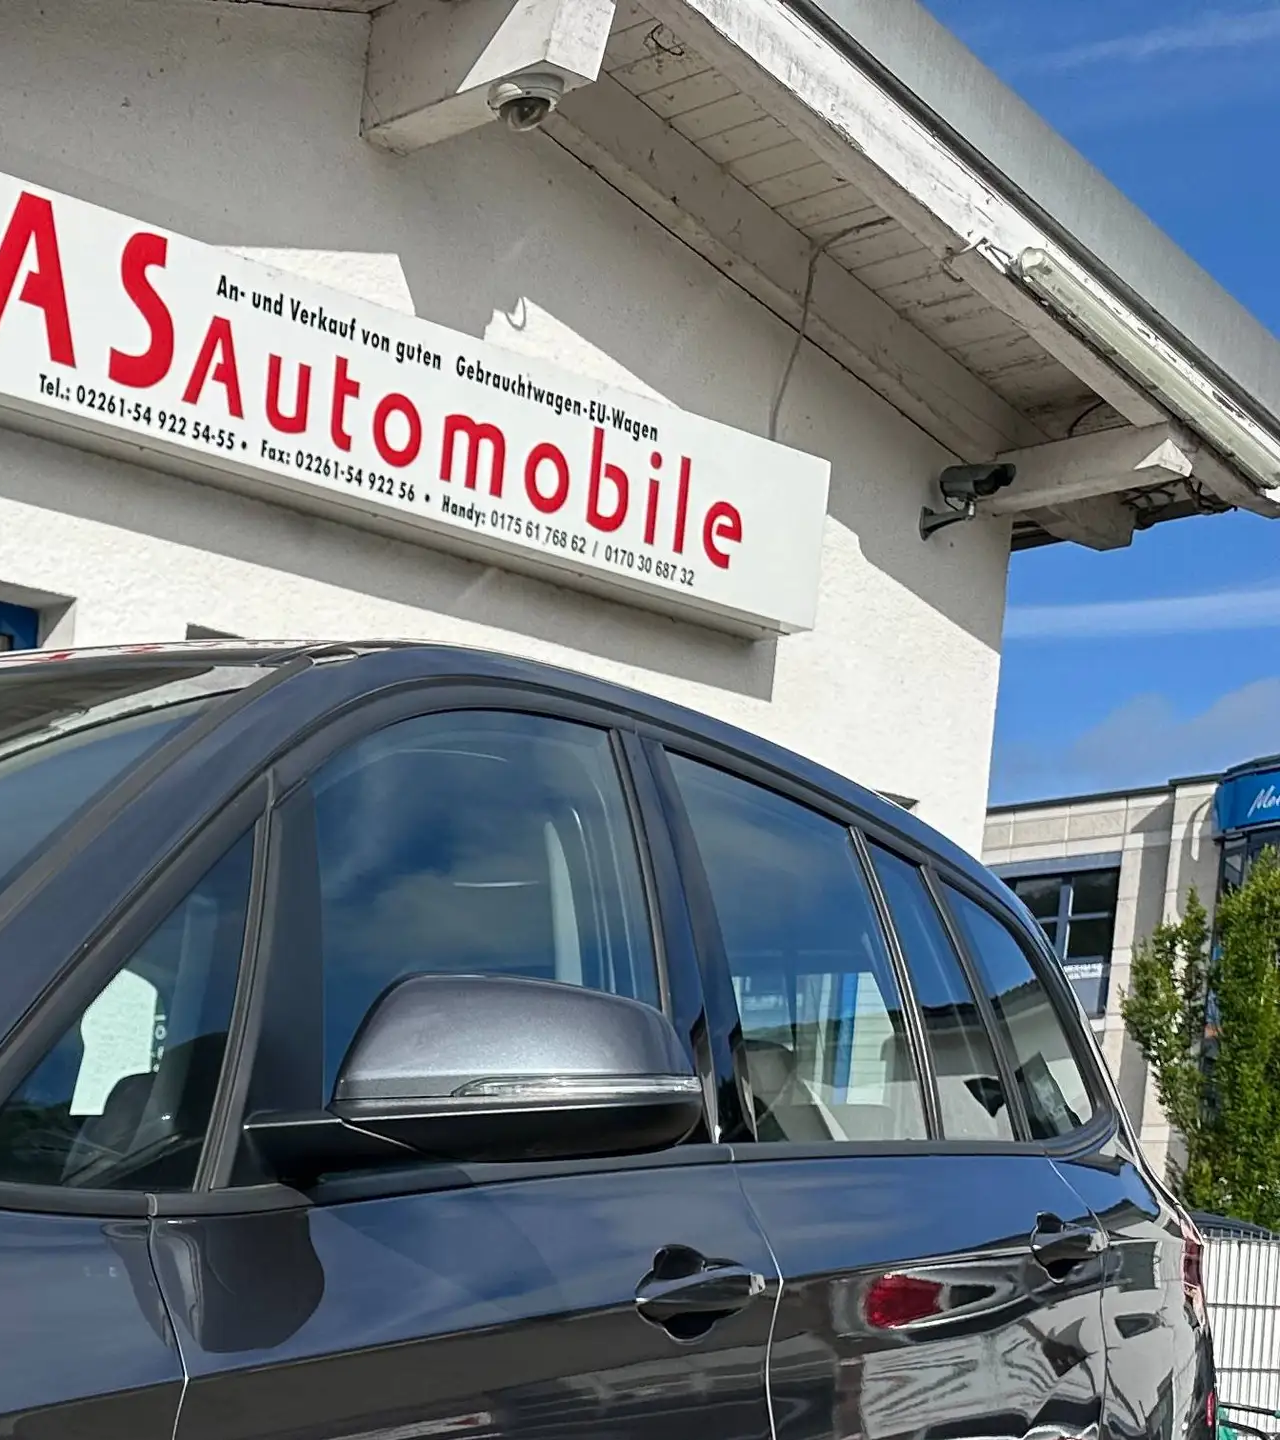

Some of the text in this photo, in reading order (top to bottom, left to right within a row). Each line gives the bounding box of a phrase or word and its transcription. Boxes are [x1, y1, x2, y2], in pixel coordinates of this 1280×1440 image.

[216, 274, 246, 303] An-
[252, 292, 284, 317] und
[290, 297, 357, 342] Verkauf
[361, 327, 390, 353] von
[396, 340, 442, 370] guten
[39, 373, 71, 401] Tel.:
[76, 385, 152, 426] 02261-54
[158, 410, 187, 436] 922
[191, 421, 236, 450] 54-55
[260, 439, 291, 466] Fax:
[295, 450, 363, 488] 02261-54
[368, 472, 394, 496] 922
[398, 483, 416, 502] 56
[441, 493, 486, 528] Handy:
[490, 511, 522, 535] 0175
[525, 520, 540, 541] 61
[544, 526, 567, 548] 768
[571, 534, 587, 554] 62
[604, 545, 634, 568] 0170
[637, 554, 652, 574] 30
[655, 559, 677, 580] 687
[680, 568, 695, 586] 32
